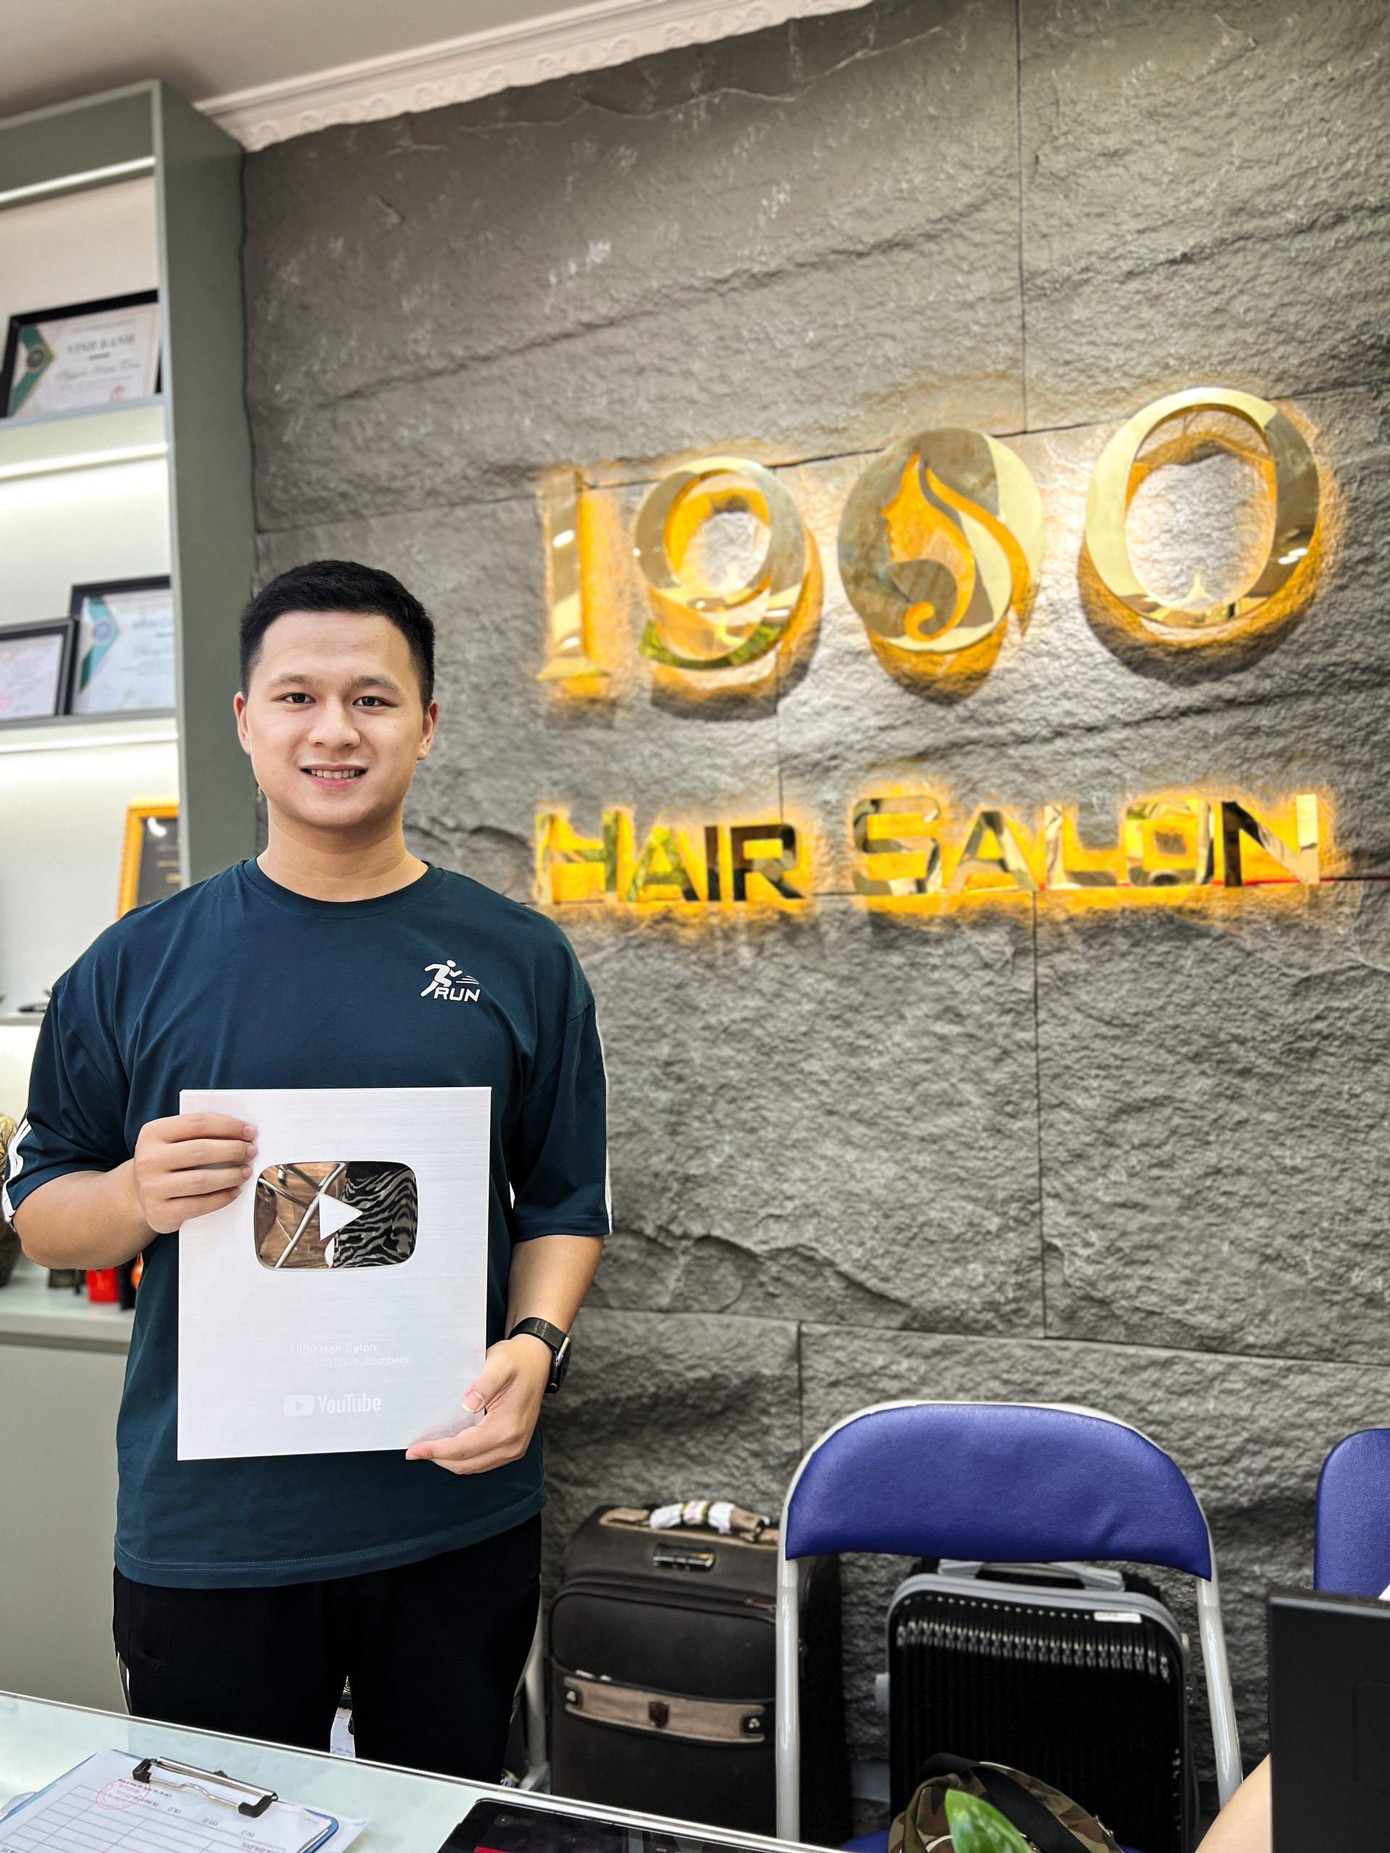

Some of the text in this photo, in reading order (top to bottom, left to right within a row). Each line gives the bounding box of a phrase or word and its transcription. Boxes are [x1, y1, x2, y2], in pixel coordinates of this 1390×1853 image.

[535, 794, 1319, 903] HAIR SALON
[434, 986, 481, 1002] RUN
[344, 1342, 377, 1353] Salon
[317, 1392, 382, 1414] YouTube
